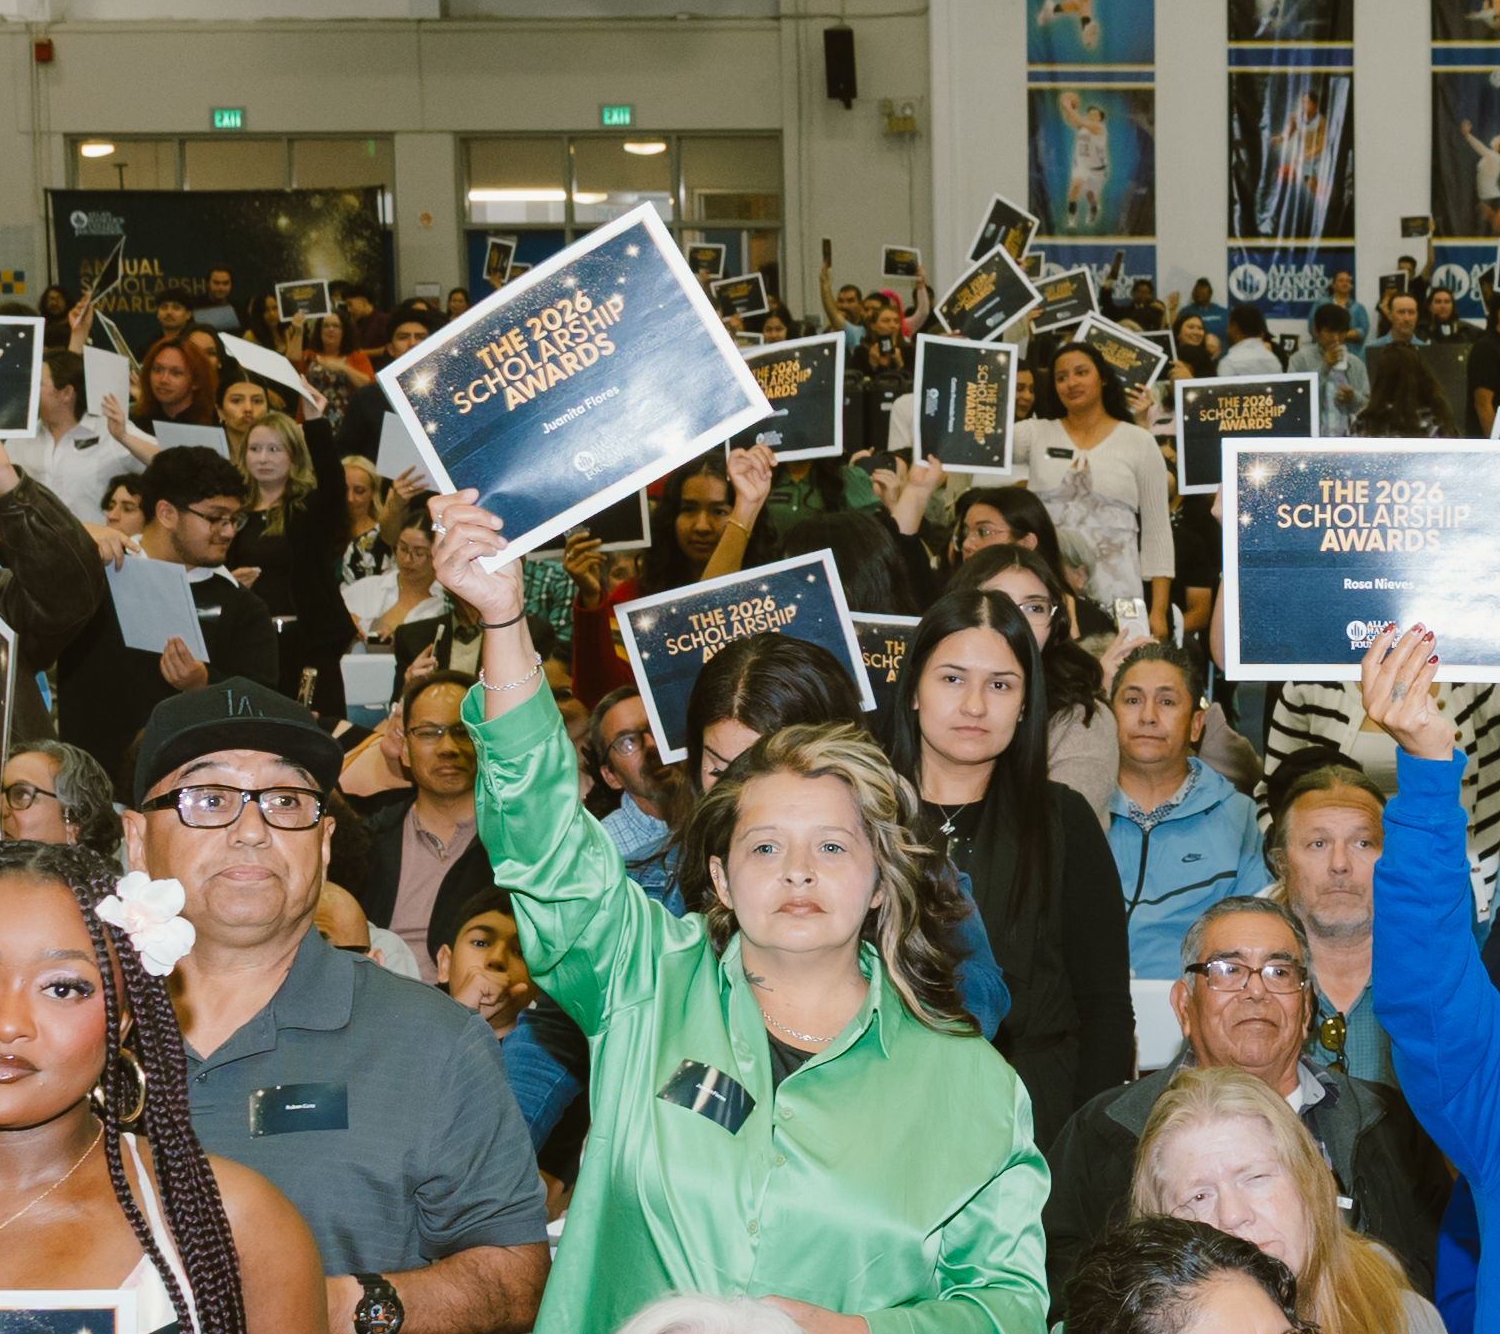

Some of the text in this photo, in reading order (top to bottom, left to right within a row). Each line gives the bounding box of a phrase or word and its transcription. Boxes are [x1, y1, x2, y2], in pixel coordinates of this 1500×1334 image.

[214, 109, 241, 128] EXIT
[603, 106, 631, 125] EXIT
[476, 290, 592, 369] THE 2026
[452, 300, 624, 414] SCHOLARSHIP
[505, 333, 616, 412] AWARDS
[543, 385, 620, 435] Juanita Flores
[1200, 405, 1285, 422] SCHOLARSHIP
[1218, 395, 1273, 408] THE 2026
[1219, 418, 1272, 431] AWARDS
[1319, 480, 1444, 504] THE 2026
[1277, 503, 1470, 529] SCHOLARSHIP
[1320, 529, 1441, 552] AWARDS
[1344, 578, 1415, 590] Rosa Nieves
[689, 595, 776, 631] THE 2026
[665, 605, 797, 656] SCHOLARSHIP
